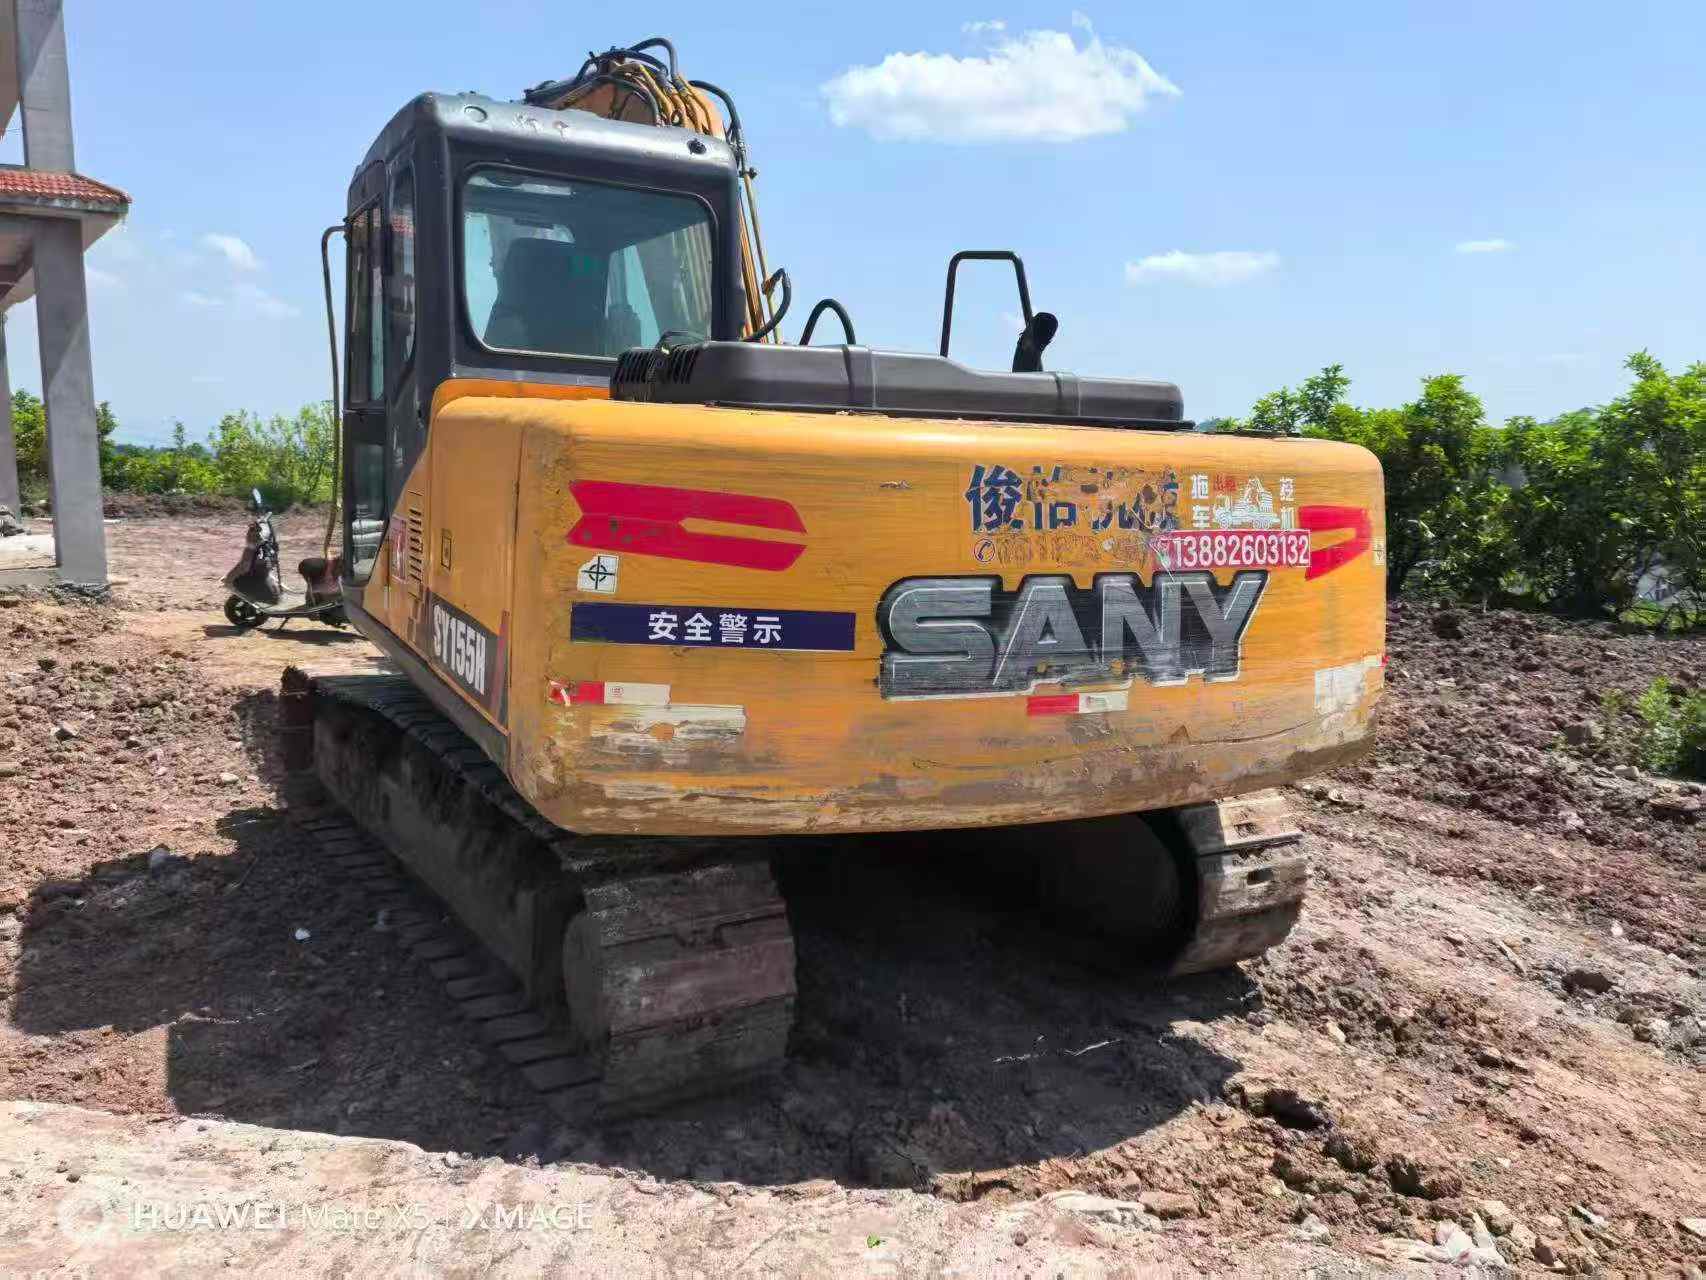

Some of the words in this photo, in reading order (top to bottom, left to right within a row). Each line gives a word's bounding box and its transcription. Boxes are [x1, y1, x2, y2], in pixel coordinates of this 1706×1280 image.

[1174, 534, 1310, 567] 13882603132
[433, 604, 486, 695] SY155H
[648, 611, 782, 644] 安全警示
[880, 570, 1269, 701] SANY
